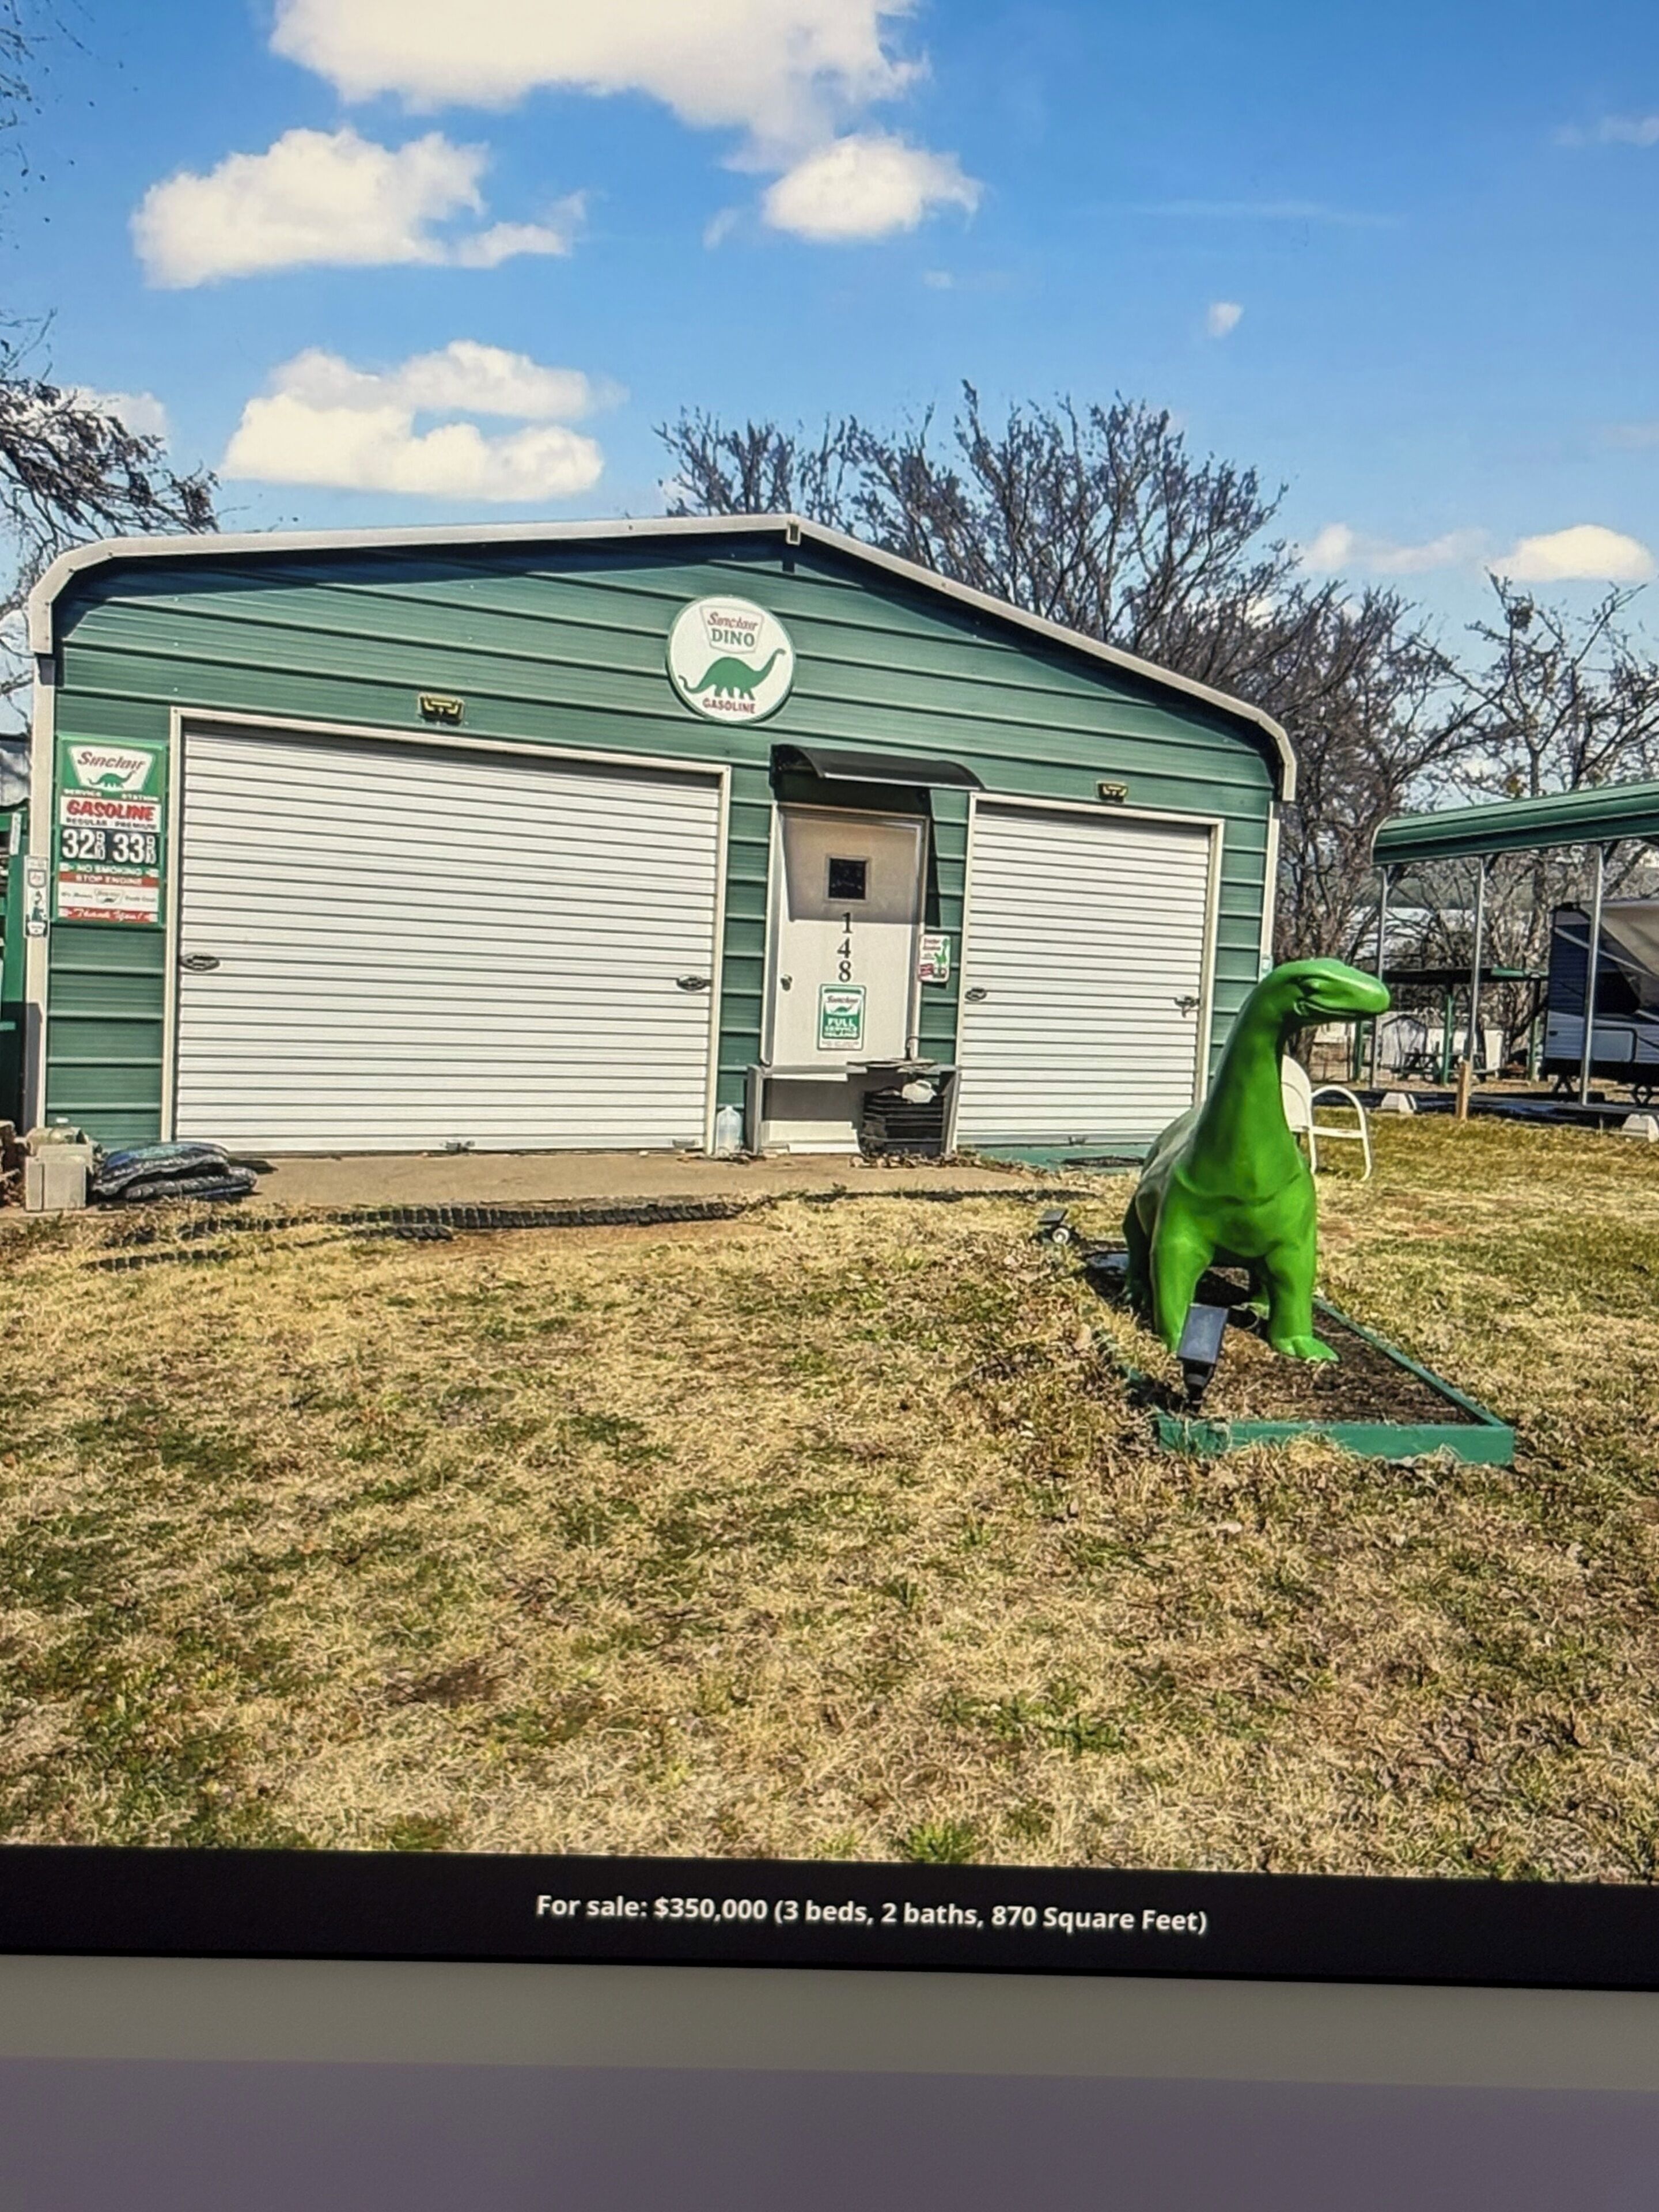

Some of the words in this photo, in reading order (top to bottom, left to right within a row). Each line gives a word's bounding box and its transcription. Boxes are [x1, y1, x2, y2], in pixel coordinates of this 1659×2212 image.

[707, 612, 758, 631] Sinclair
[711, 628, 755, 647] DINO
[702, 698, 756, 714] GASOLINE
[77, 751, 146, 771] Sinclair
[66, 799, 156, 821] GASOLINE
[66, 817, 108, 825] REGULAR
[115, 821, 157, 830] PREMIUM
[75, 863, 93, 873] NO
[94, 865, 143, 876] SMOKING
[75, 874, 103, 882] STOP
[105, 876, 143, 885] ENGINE
[828, 1018, 857, 1027] FULL
[536, 1895, 581, 1915] For
[586, 1895, 647, 1917] sale:
[654, 1896, 767, 1923] $350,000
[774, 1899, 798, 1924] (3
[806, 1900, 874, 1925] beds,
[881, 1903, 897, 1923] 2
[904, 1903, 984, 1929] baths,
[991, 1906, 1036, 1926] 870
[1043, 1907, 1135, 1933] Square
[1142, 1910, 1207, 1934] Feet)
